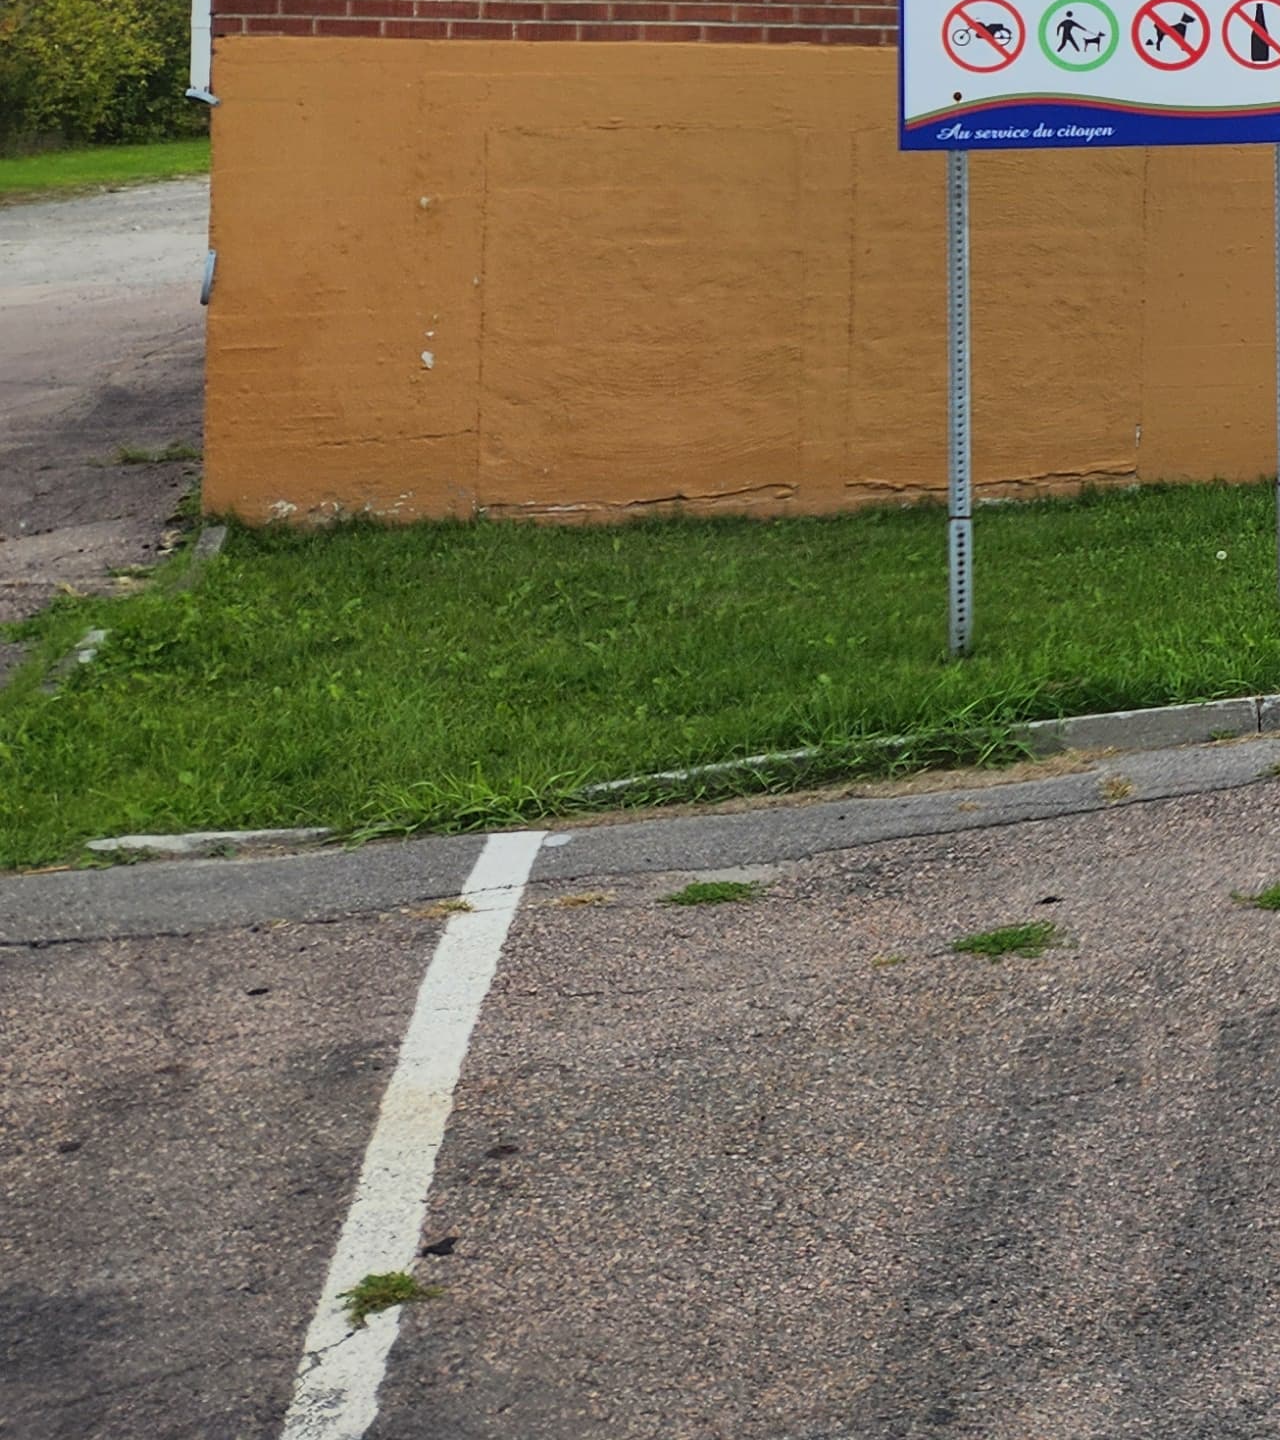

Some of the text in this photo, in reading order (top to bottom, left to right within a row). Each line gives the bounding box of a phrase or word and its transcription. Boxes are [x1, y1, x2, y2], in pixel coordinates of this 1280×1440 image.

[936, 123, 1115, 142] Au service du citoyen
